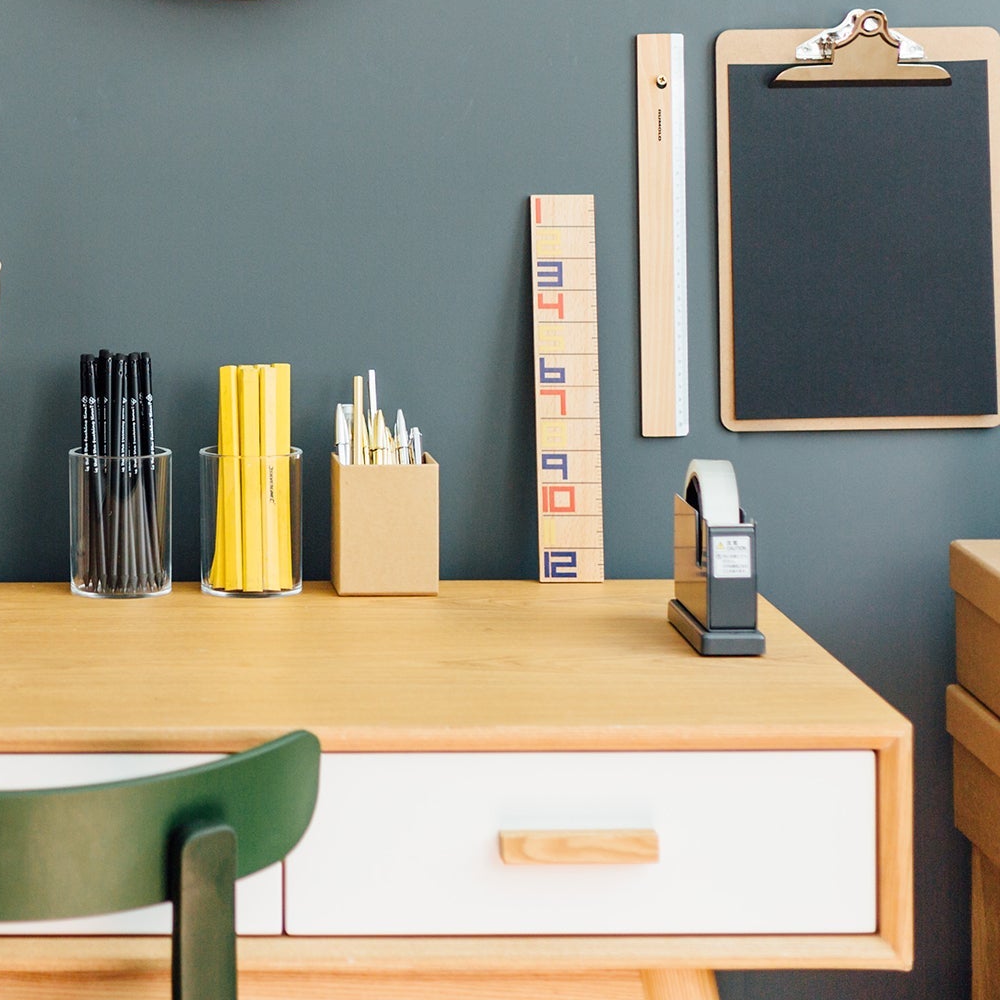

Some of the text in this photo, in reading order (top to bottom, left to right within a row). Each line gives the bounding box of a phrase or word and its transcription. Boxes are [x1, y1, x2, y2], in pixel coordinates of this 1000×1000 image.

[536, 229, 562, 256] 2
[536, 261, 563, 288] 3
[537, 293, 564, 319] 4
[538, 325, 565, 352] 5
[539, 357, 566, 384] 6
[539, 389, 567, 416] 7
[540, 421, 567, 448] 8
[541, 453, 568, 480] 9
[542, 485, 575, 513] 10
[544, 551, 577, 578] 12
